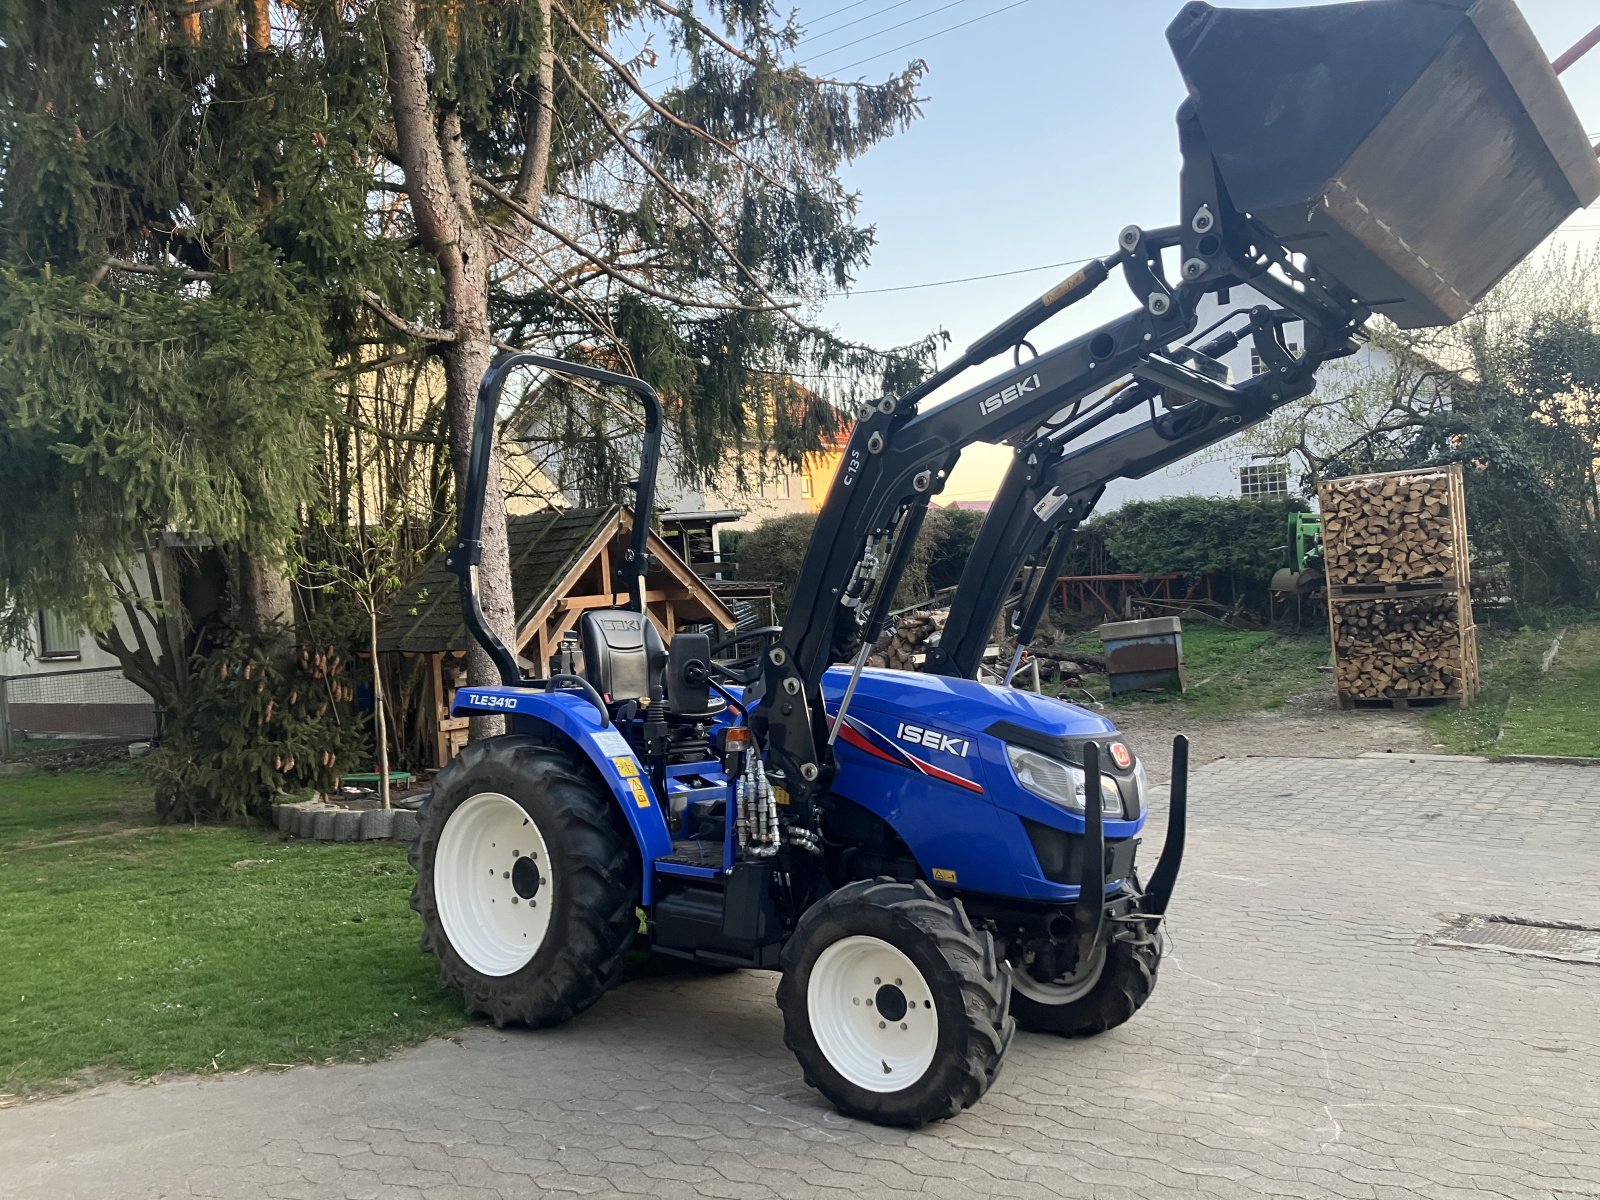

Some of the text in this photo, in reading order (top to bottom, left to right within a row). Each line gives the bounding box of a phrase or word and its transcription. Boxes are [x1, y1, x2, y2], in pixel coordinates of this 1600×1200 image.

[979, 373, 1041, 416] ISEKI
[469, 694, 518, 709] TLE3410
[896, 722, 970, 758] ISEKI
